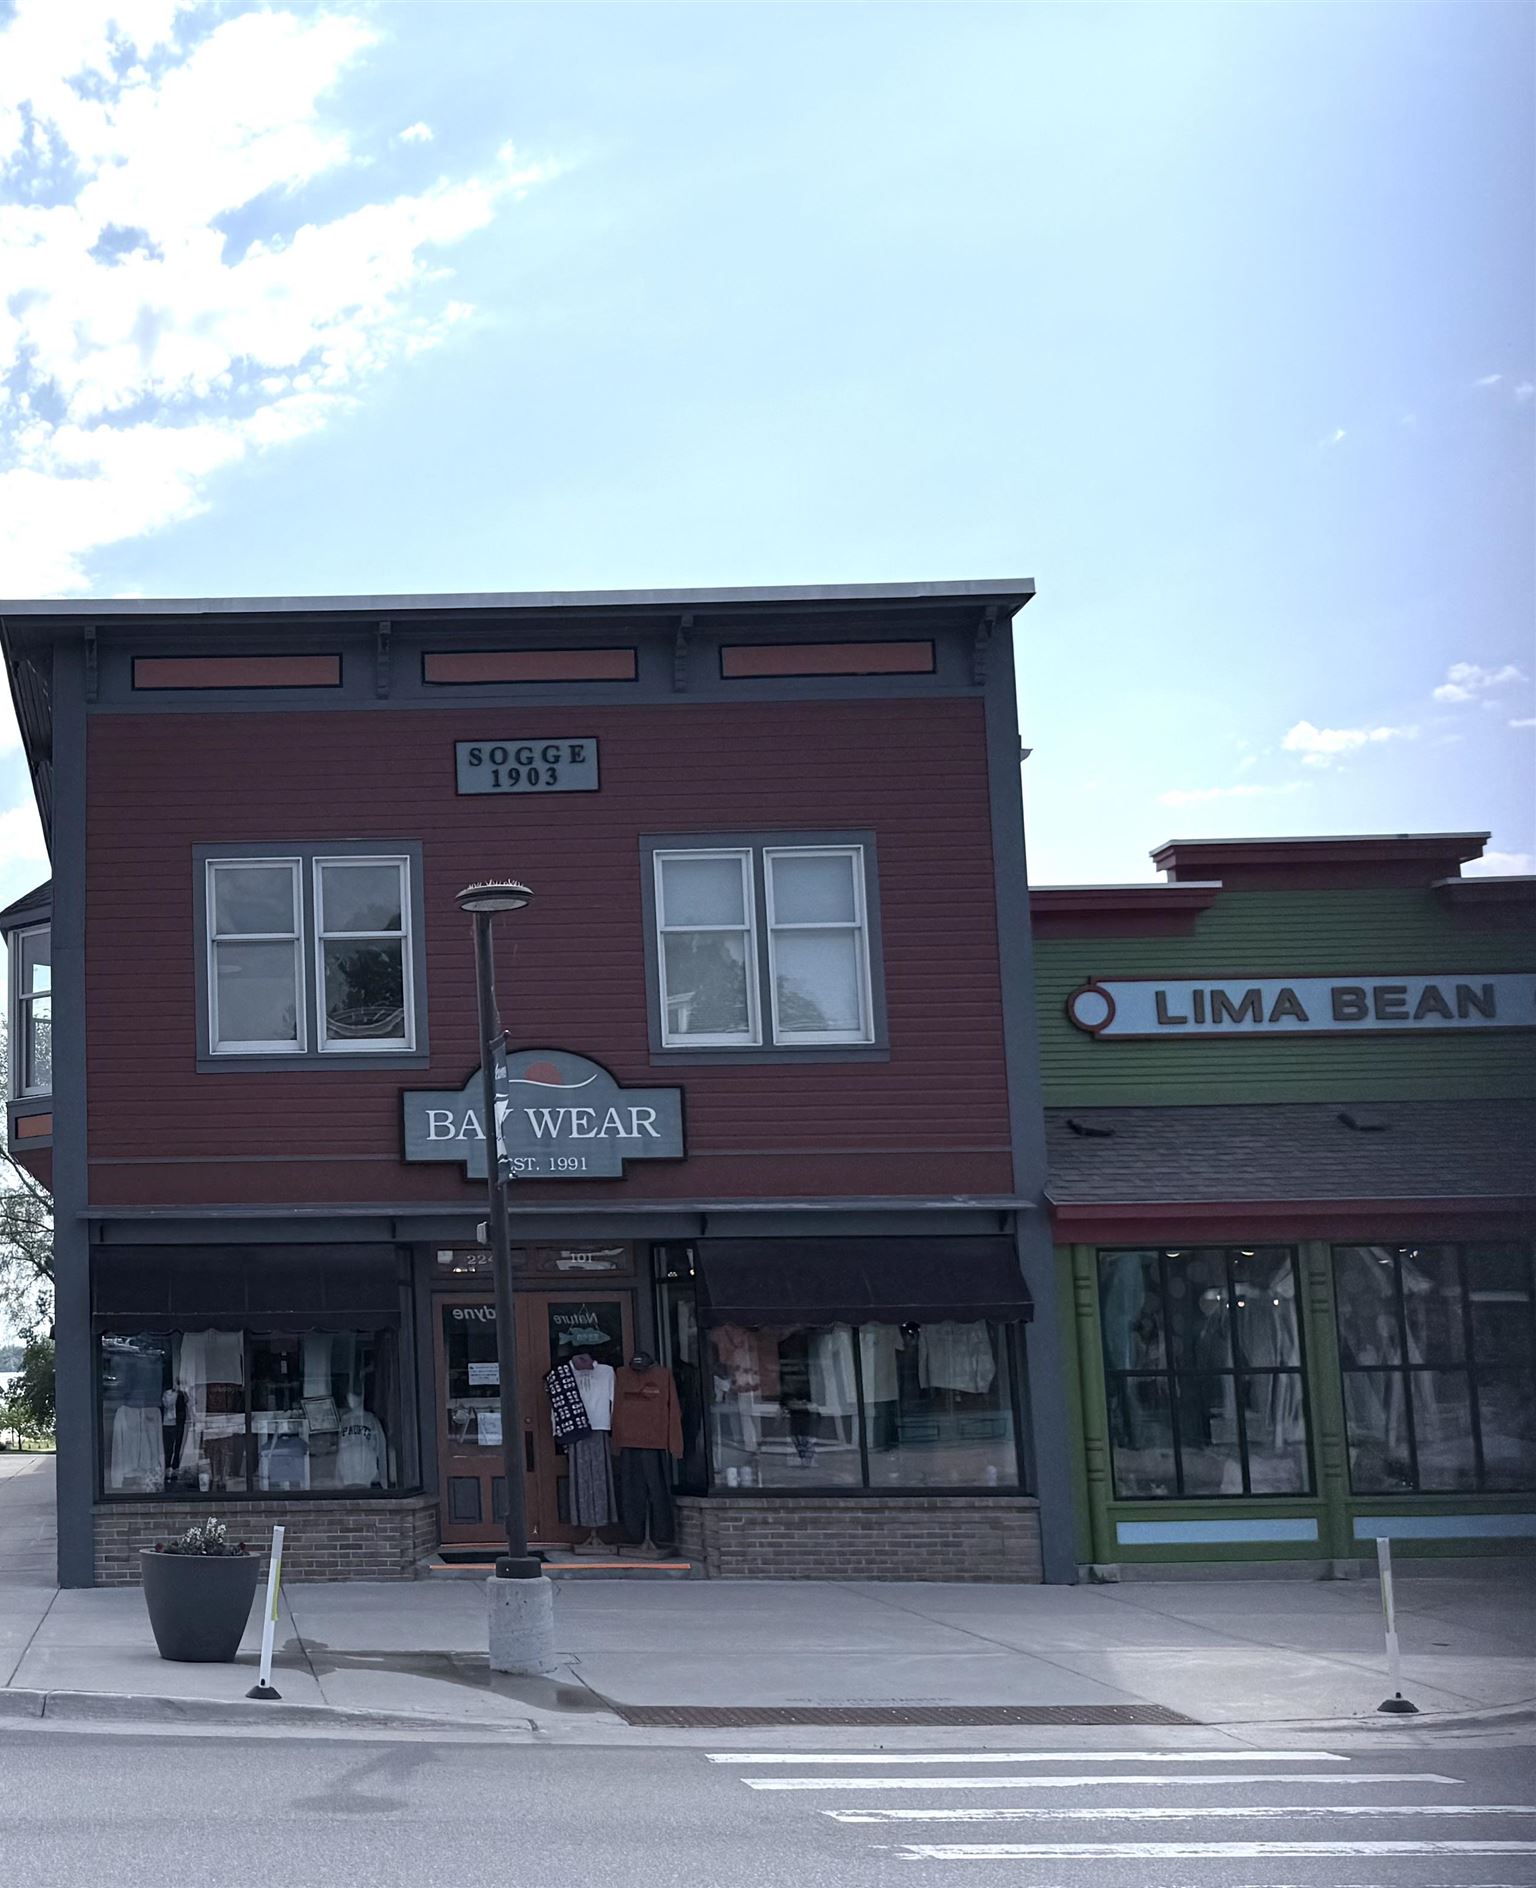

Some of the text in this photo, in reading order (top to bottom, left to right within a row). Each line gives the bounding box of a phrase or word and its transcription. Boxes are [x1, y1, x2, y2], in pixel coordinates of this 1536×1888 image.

[468, 744, 586, 767] SOGGE
[491, 767, 558, 787] 1903
[1155, 988, 1309, 1025] LIMA
[1331, 983, 1497, 1022] BEAN
[524, 1106, 661, 1138] WEAR
[507, 1156, 588, 1171] ST. 1991
